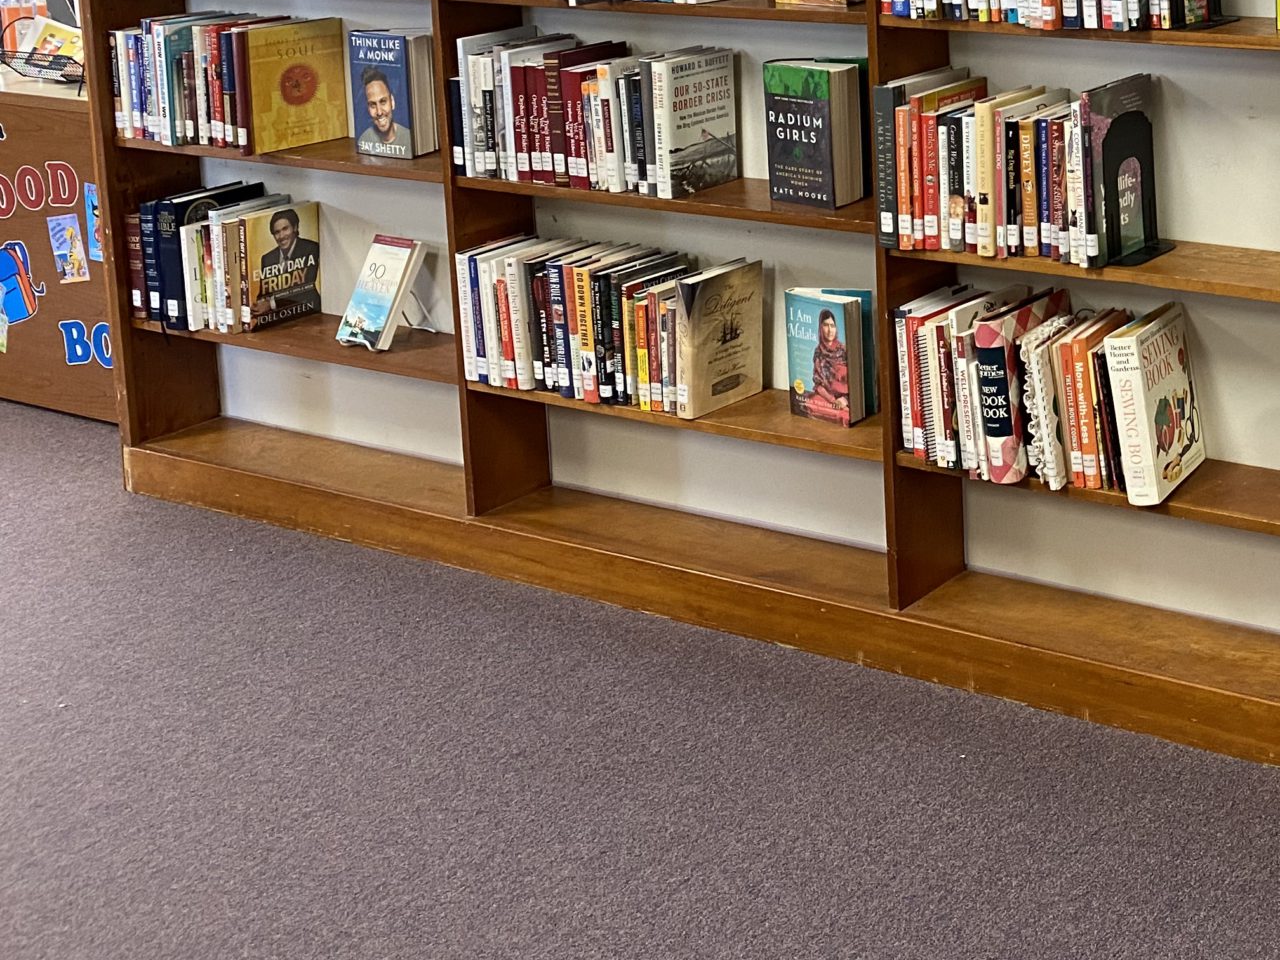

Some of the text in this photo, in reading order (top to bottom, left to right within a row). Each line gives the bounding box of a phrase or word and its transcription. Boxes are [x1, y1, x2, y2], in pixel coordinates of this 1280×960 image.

[351, 36, 400, 50] THINK LIKE
[358, 49, 396, 61] A MONK
[673, 75, 729, 98] OUR 50-STATE
[672, 88, 731, 112] BORDER CRISIS
[768, 110, 823, 128] RADIUM
[776, 128, 817, 144] GIRLS
[360, 140, 406, 156] JAY SHETTY
[1021, 134, 1033, 176] DEWEY
[773, 186, 828, 201] KATE MOORE
[253, 255, 315, 281] EVERY DAY A
[262, 268, 307, 293] FRIDAY
[257, 301, 314, 326] JOEL OSTEEN
[789, 307, 812, 324] I Am
[787, 322, 817, 342] Malala
[1141, 325, 1180, 361] SEWING
[1145, 354, 1175, 392] BOOK
[960, 369, 972, 441] WELL-PRESERVED
[1074, 362, 1089, 444] More-with-Less
